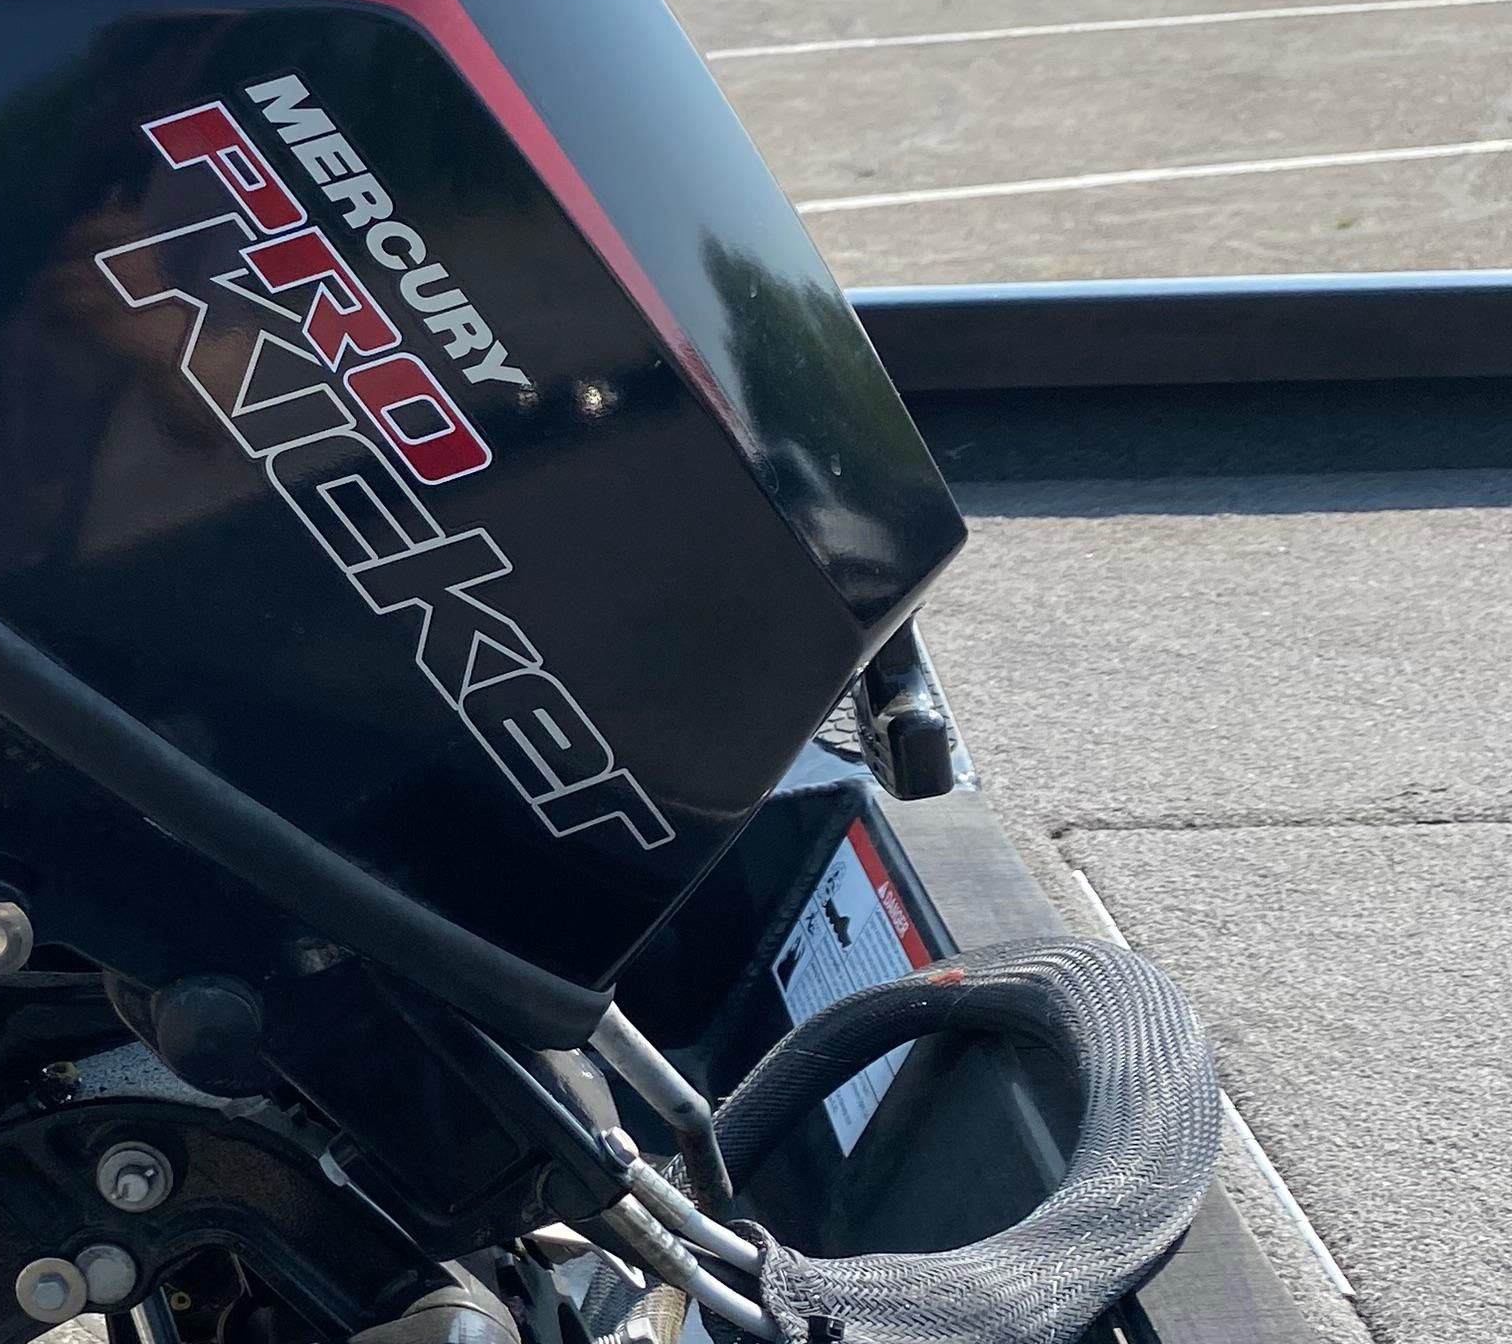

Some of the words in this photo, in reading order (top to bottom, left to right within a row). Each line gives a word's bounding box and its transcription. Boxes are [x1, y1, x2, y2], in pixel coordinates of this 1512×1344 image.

[142, 101, 491, 485] PRO
[245, 74, 532, 389] MERCURY
[883, 890, 909, 939] DANGER
